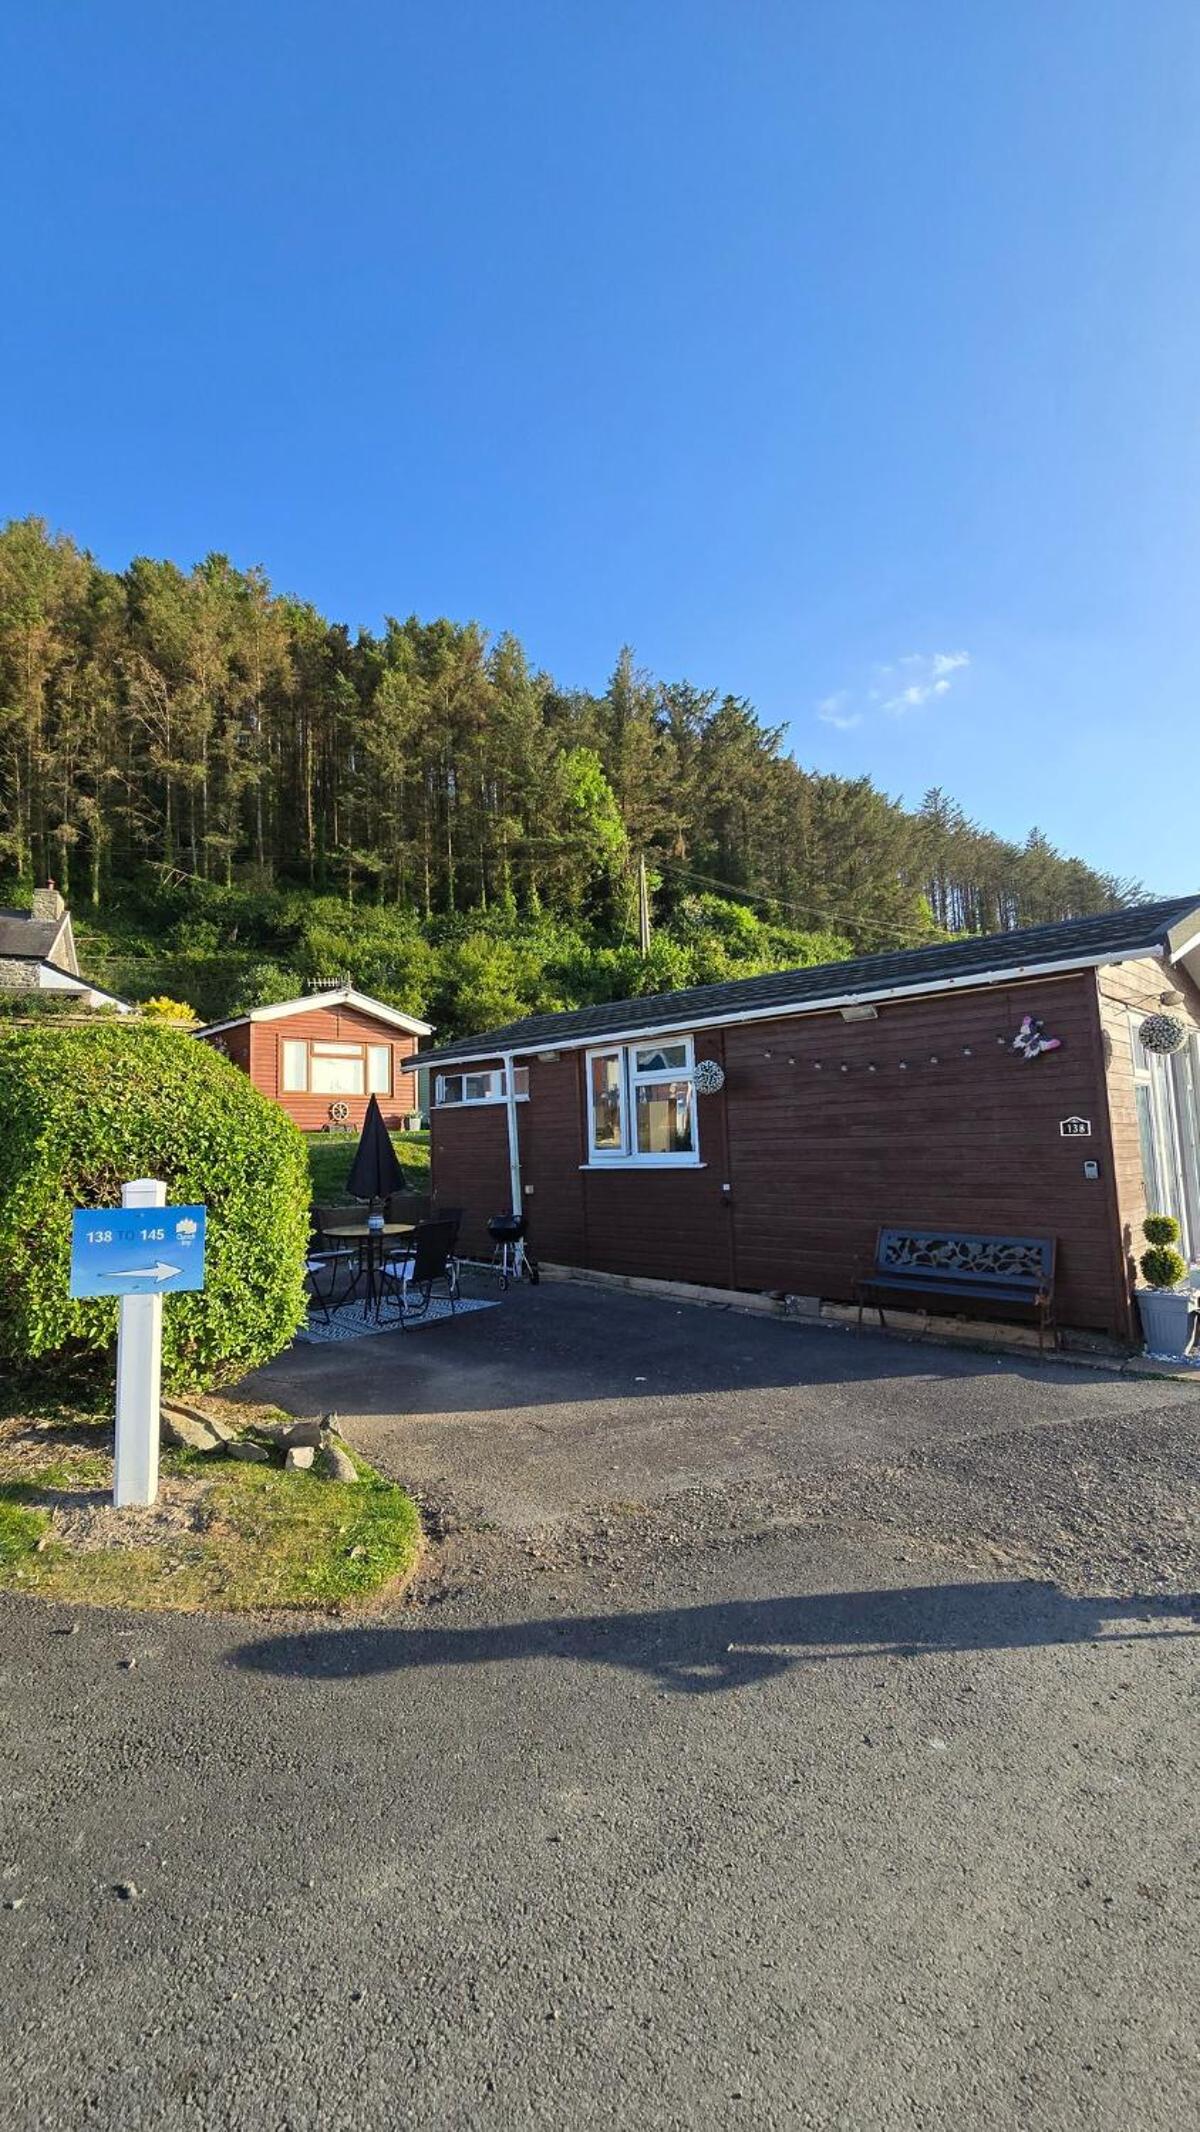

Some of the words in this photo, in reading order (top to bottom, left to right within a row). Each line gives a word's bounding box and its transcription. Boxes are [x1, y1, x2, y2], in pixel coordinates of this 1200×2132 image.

[1067, 1124, 1086, 1133] 138
[86, 1231, 112, 1243] 138
[118, 1230, 134, 1240] TO
[140, 1228, 165, 1240] 145
